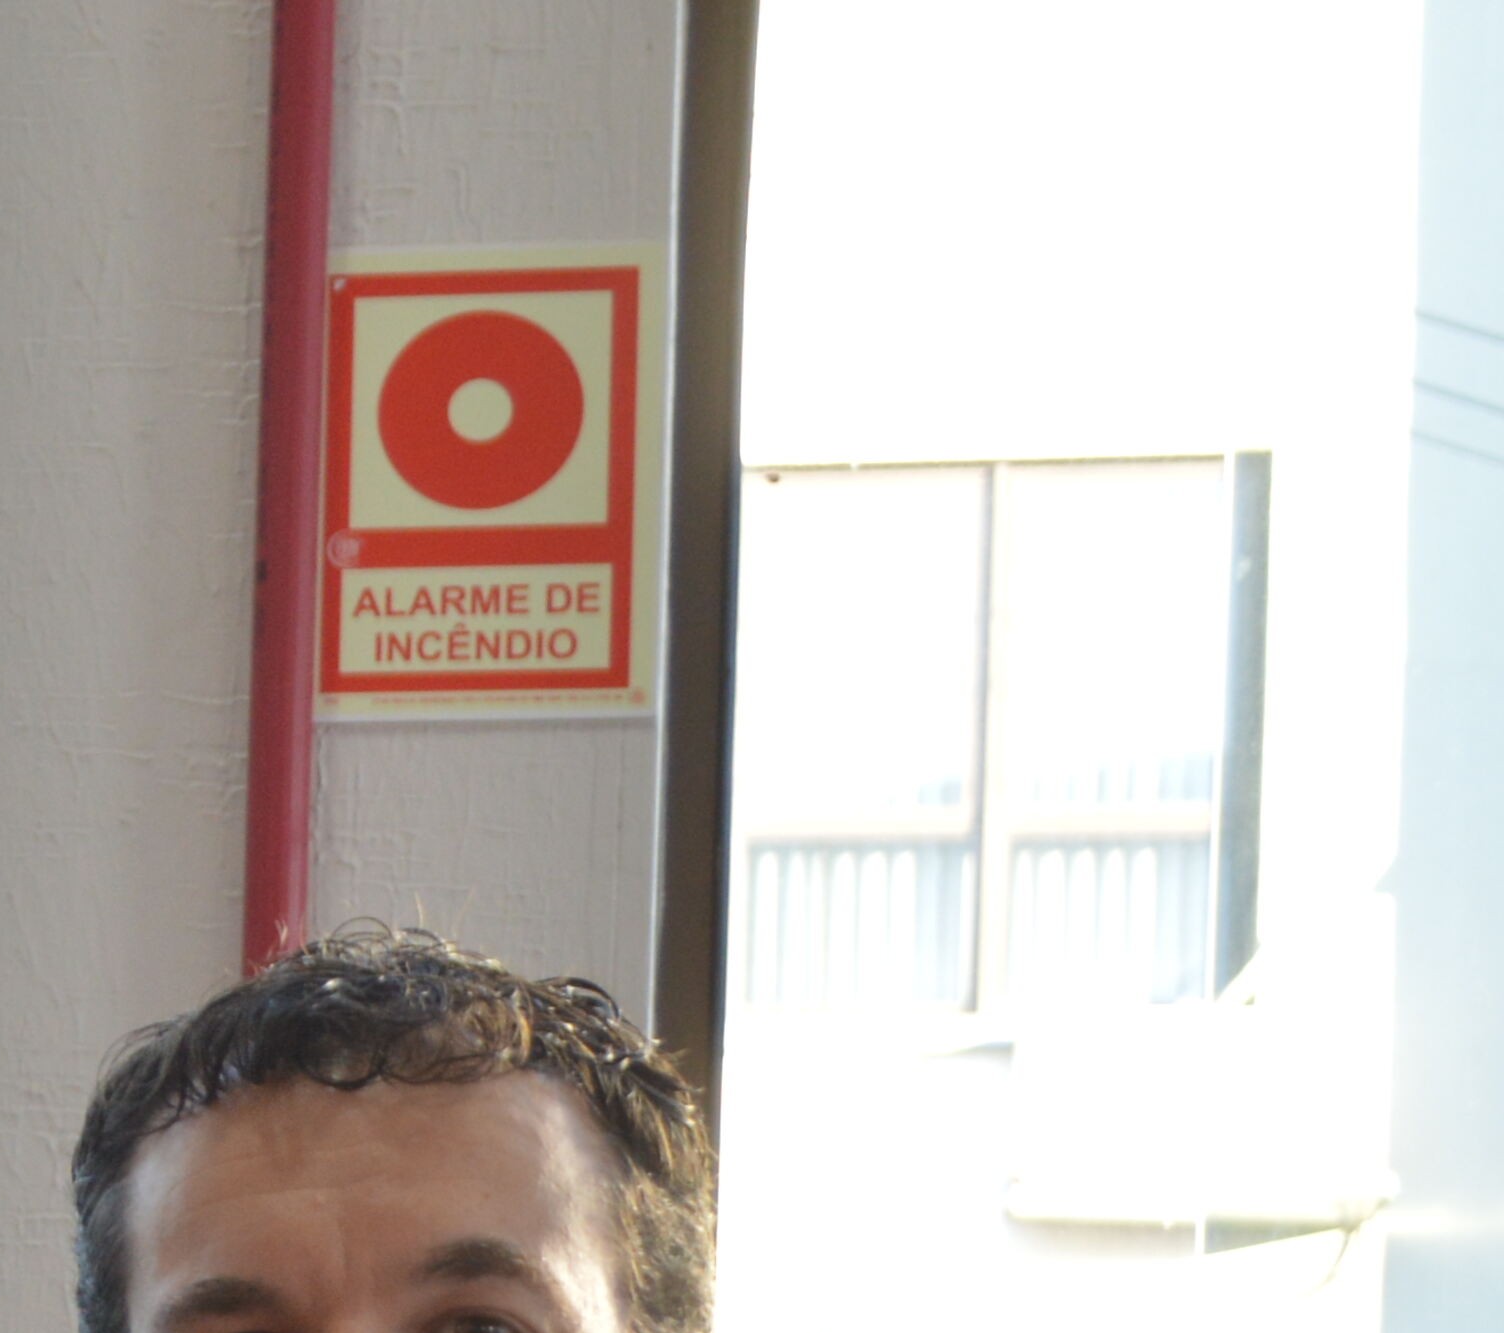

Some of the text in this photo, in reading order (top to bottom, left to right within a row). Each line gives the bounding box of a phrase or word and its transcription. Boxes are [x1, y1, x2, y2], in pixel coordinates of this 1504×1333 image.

[352, 582, 602, 618] ALARME DE
[374, 624, 578, 662] INCÊNDIO
